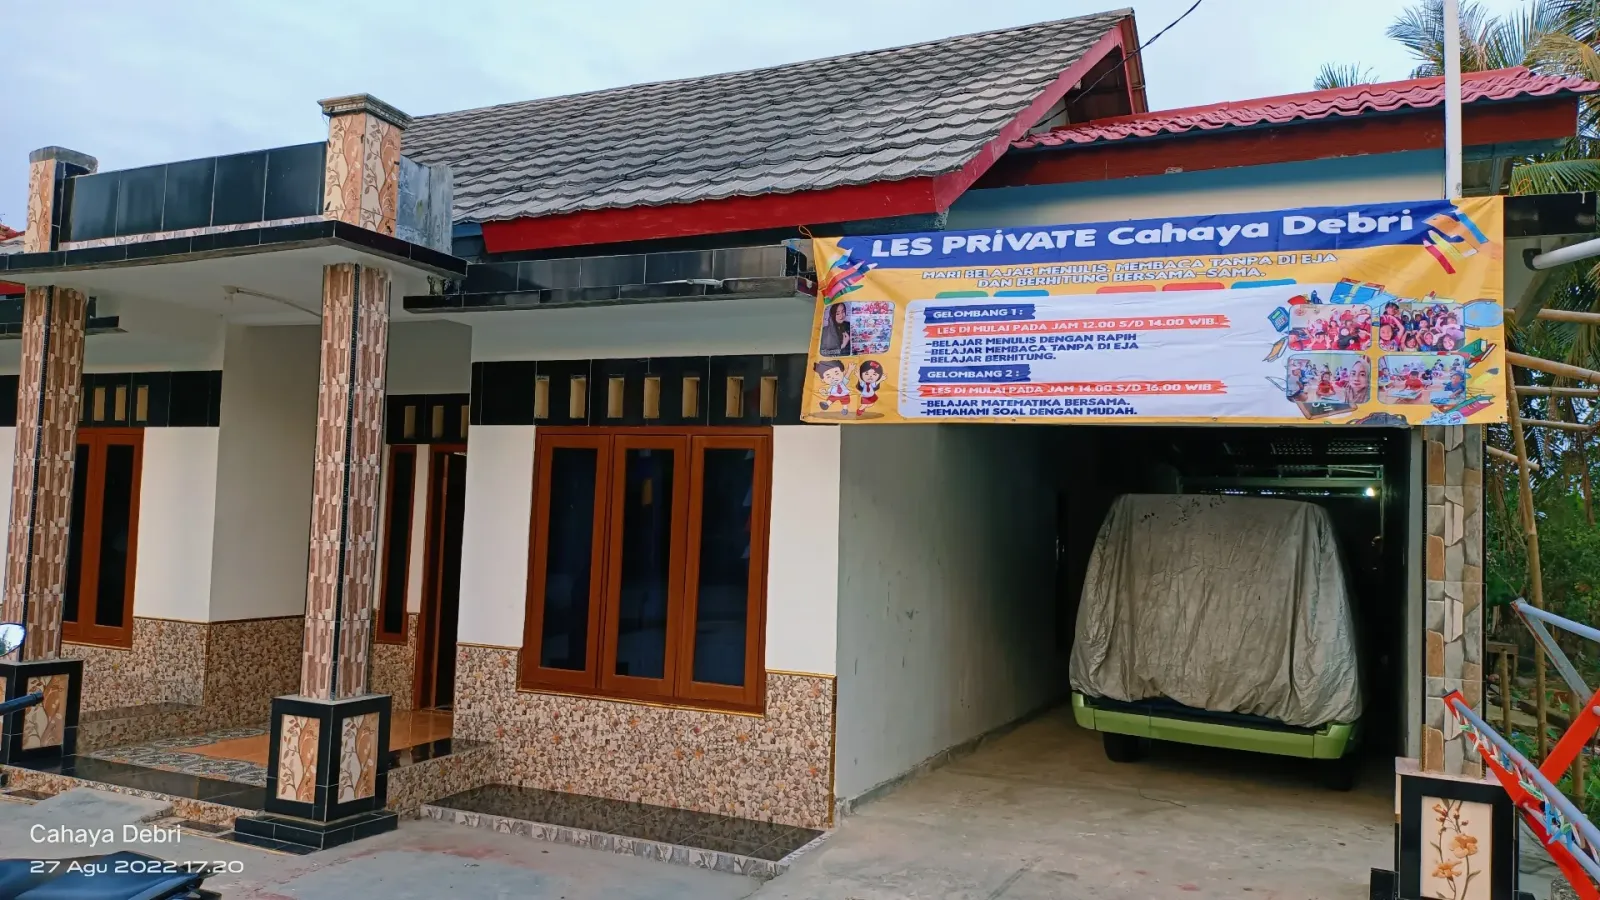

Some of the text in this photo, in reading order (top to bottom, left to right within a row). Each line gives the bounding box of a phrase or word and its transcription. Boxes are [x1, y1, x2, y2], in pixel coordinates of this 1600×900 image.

[871, 237, 932, 257] LES
[1108, 221, 1269, 246] Cahaya
[1283, 209, 1412, 236] Debri
[922, 270, 961, 280] MARI
[964, 267, 1034, 279] BELAJAR
[1116, 259, 1204, 272] MEMBACA
[1209, 255, 1276, 267] TANPA
[1277, 254, 1297, 265] DI
[1301, 253, 1338, 264] EJA
[977, 279, 1012, 288] DAN
[1016, 273, 1108, 287] BERHITUNG
[933, 308, 1008, 319] GELOMBANG
[937, 327, 956, 335] LES
[959, 325, 970, 333] DI
[973, 324, 1010, 333] MULAI
[1013, 323, 1047, 331] PADA
[1052, 322, 1078, 330] JAM
[1083, 321, 1115, 329] 12.00
[1119, 320, 1144, 328] S/D
[1149, 318, 1184, 326] 14.00
[985, 336, 1036, 345] MENULIS
[1039, 334, 1094, 343] DENGAN
[1097, 333, 1137, 341] RAPIH
[985, 344, 1047, 354] MEMBACA
[1050, 343, 1094, 351] TANPA
[1097, 342, 1110, 350] DI
[1113, 342, 1139, 350] EJA
[985, 353, 1056, 362] BERHITUNG.
[927, 370, 1002, 379] GELOMBANG
[969, 386, 1005, 394] MULAI
[1048, 385, 1074, 393] JAM
[1079, 384, 1112, 392] 14.00
[1116, 384, 1141, 392] S/D
[1145, 383, 1181, 391] 16.00
[981, 398, 1061, 407] MATEMATIKA
[1064, 398, 1130, 406] BERSAMA.
[992, 408, 1026, 416] SOAL
[1029, 407, 1083, 416] DENGAN
[1086, 407, 1137, 415] MUDAH.
